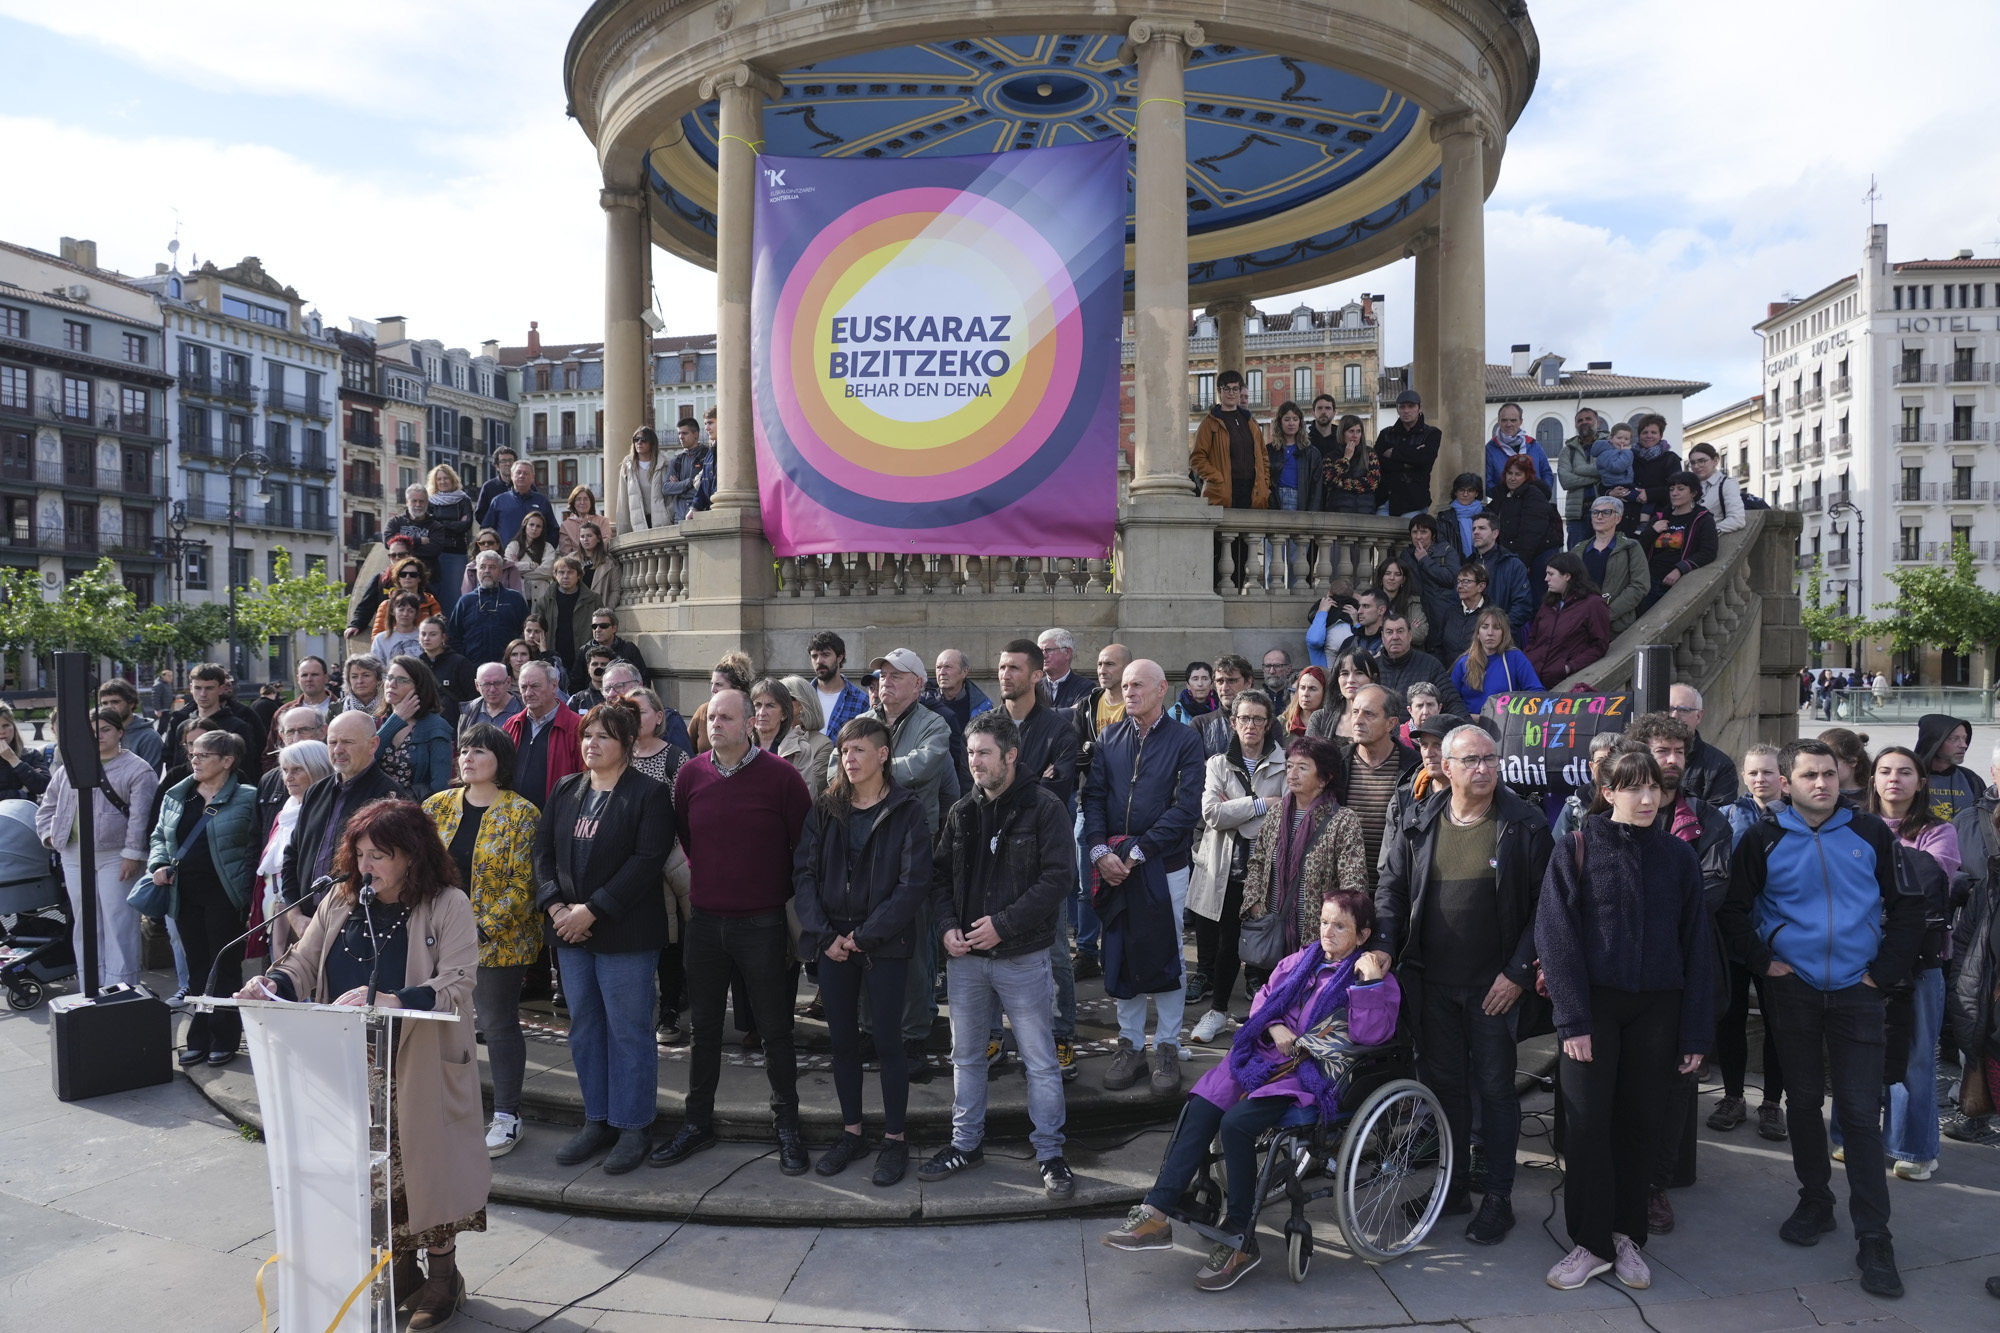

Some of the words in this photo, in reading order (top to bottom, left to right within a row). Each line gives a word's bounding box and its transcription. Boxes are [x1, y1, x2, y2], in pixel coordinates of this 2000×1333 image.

[831, 315, 1012, 344] EUSKARAZ
[1897, 315, 1982, 333] HOTEL
[829, 349, 1011, 379] BIZITZEKO
[1767, 352, 1799, 377] GRAN
[1812, 329, 1854, 357] HOTEL
[845, 383, 899, 398] BEHAR
[904, 382, 939, 397] DEN
[944, 382, 992, 397] DENA
[1496, 695, 1627, 716] euskaraz
[1525, 720, 1576, 749] bizi
[1928, 788, 1966, 796] PULTURA
